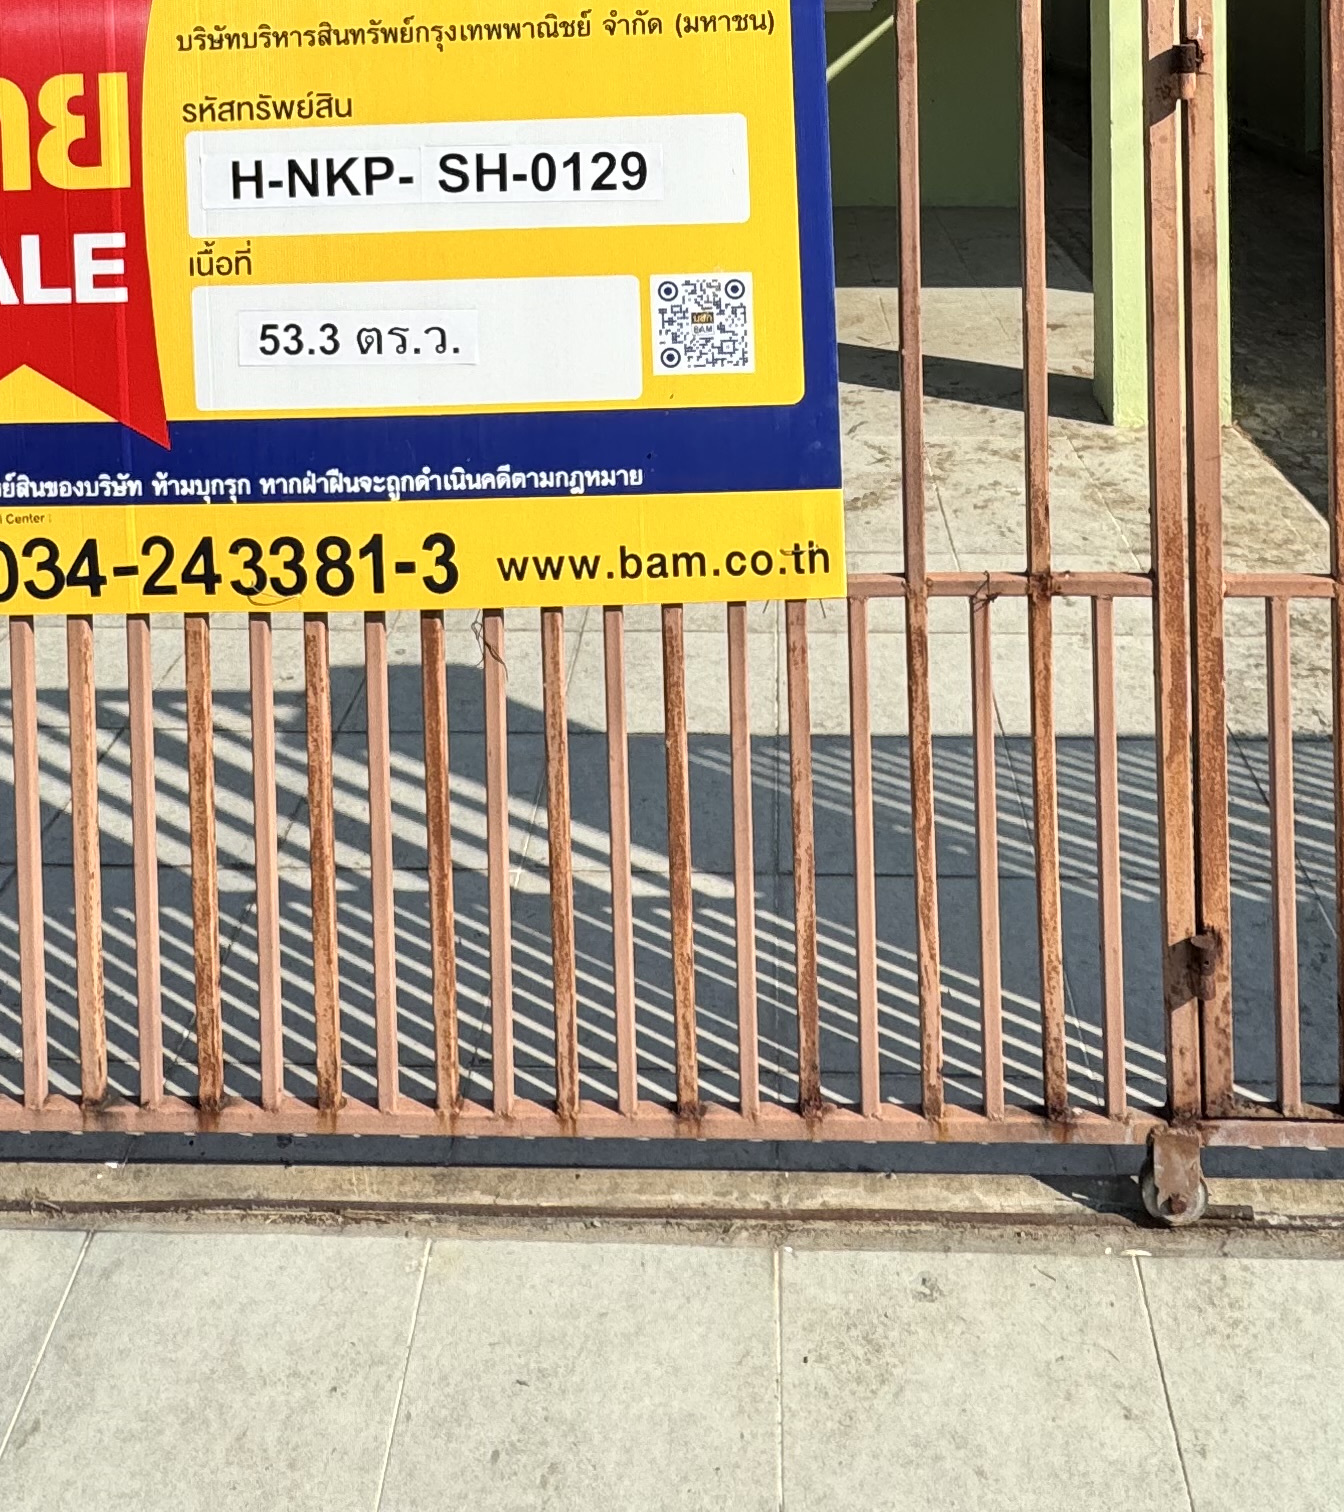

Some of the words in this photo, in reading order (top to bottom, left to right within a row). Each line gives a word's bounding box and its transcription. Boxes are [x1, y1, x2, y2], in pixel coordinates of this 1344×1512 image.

[176, 10, 591, 54] บริษัทบริหารสินทรัพย์กรุงเทพพาณิชย์
[602, 10, 663, 37] จำกัด
[674, 9, 776, 39] (มหาชน)
[182, 91, 353, 124] รหัสทรัพย์สิน
[231, 156, 414, 200] H-NKP-
[437, 150, 648, 194] SH-0129
[188, 240, 253, 277] เนื้อที่
[259, 323, 341, 356] 53.3
[355, 325, 461, 355] ตร.ว.
[152, 471, 251, 504] ห้ามบุกรุก
[5, 512, 45, 525] Center
[497, 540, 830, 582] www.bam.co.th
